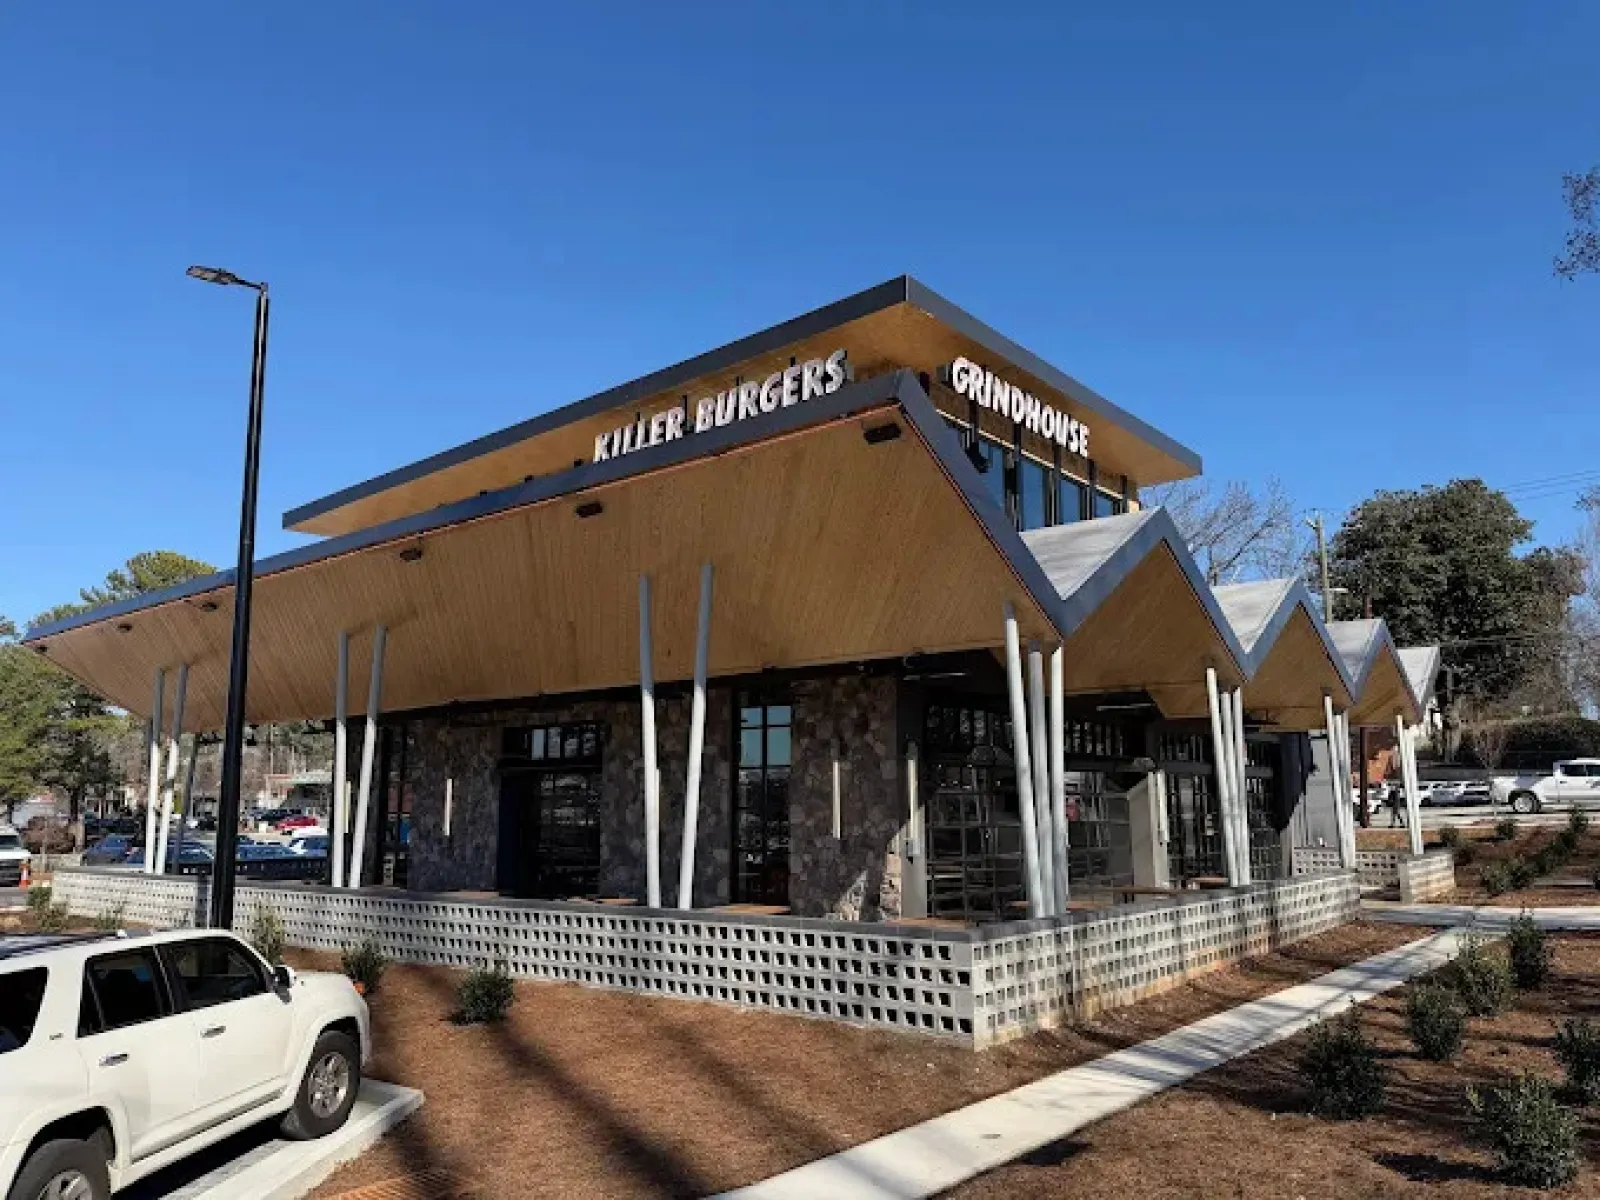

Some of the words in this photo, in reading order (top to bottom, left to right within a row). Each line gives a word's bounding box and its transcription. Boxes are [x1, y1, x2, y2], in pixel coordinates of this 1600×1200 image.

[593, 406, 685, 463] KILLER
[695, 349, 847, 433] BURGERS
[952, 356, 1090, 457] GRINDHOUSE
